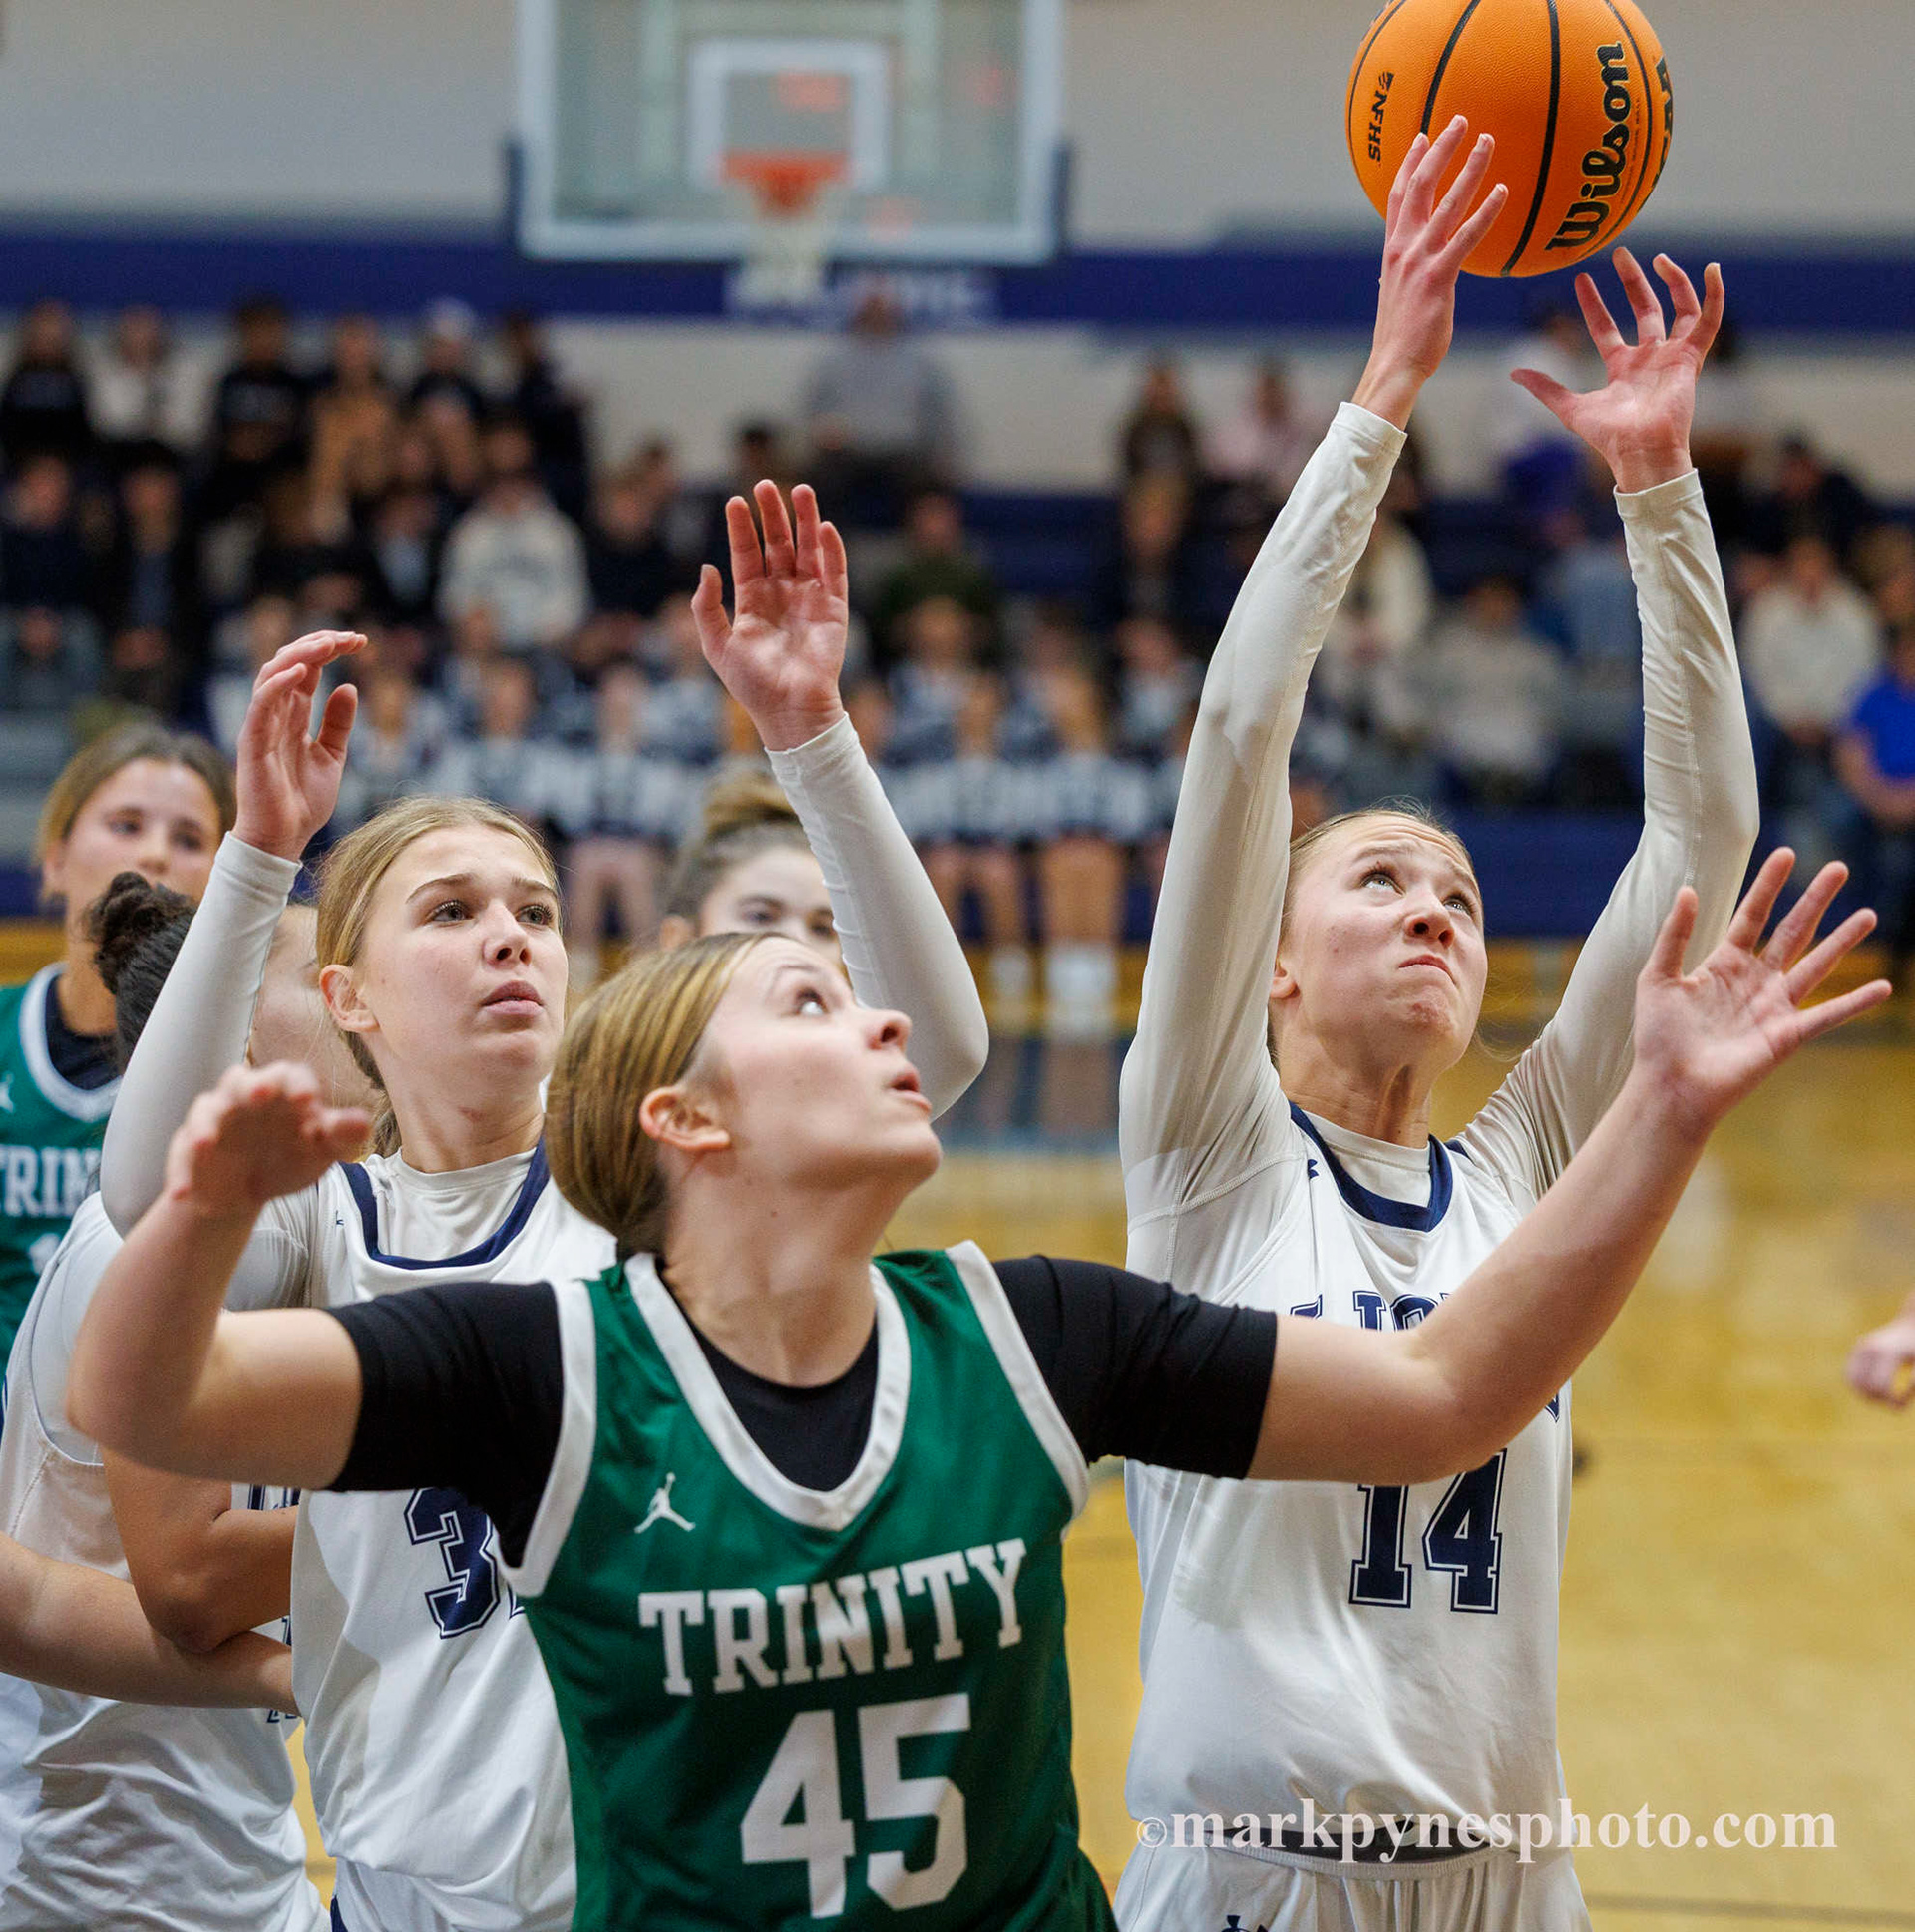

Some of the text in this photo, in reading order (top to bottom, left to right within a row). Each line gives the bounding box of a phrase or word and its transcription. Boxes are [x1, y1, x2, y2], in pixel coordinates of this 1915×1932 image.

[1368, 90, 1388, 162] NFHS
[1544, 41, 1632, 251] Wilson
[1349, 1447, 1507, 1614] 14
[638, 1537, 1027, 1696] TRINITY
[741, 1693, 971, 1918] 45
